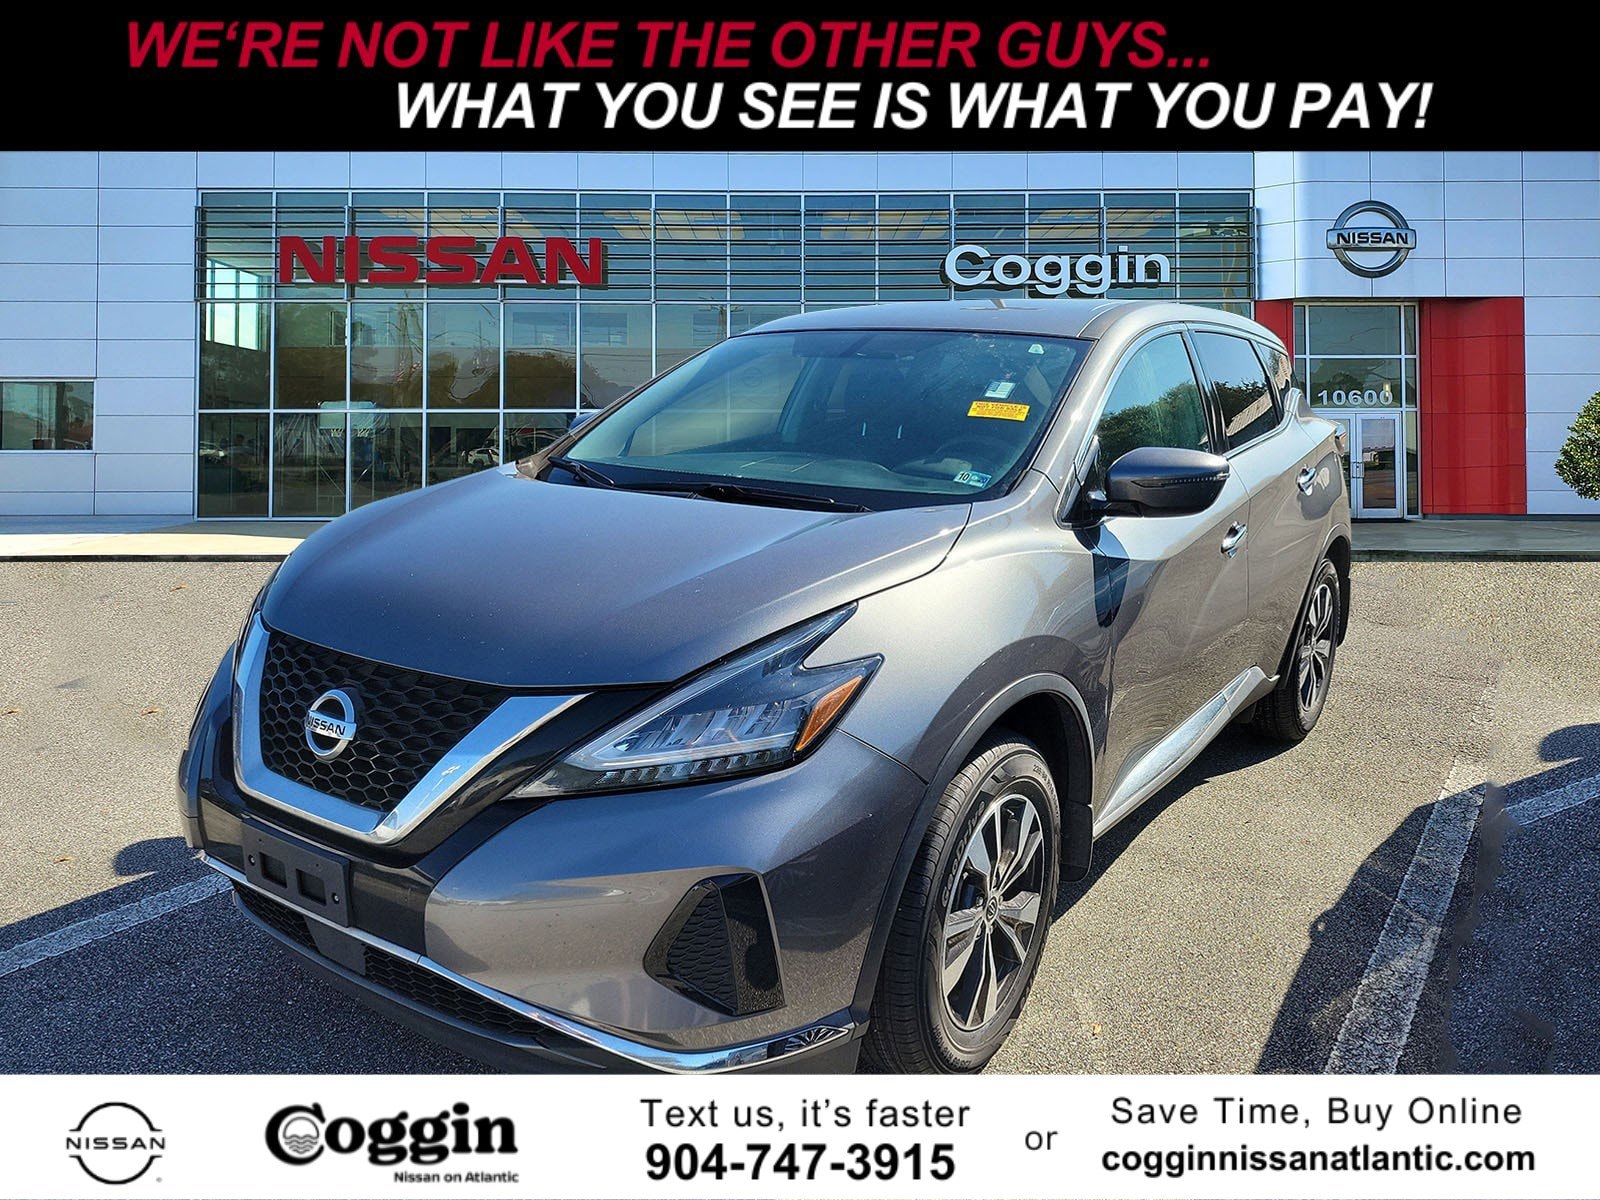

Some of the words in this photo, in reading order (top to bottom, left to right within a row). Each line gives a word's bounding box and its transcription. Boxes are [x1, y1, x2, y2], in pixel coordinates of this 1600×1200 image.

[1336, 231, 1409, 245] NISSAN
[279, 236, 602, 285] NISSAN
[943, 244, 1172, 296] Coggin
[1317, 389, 1394, 406] 10600
